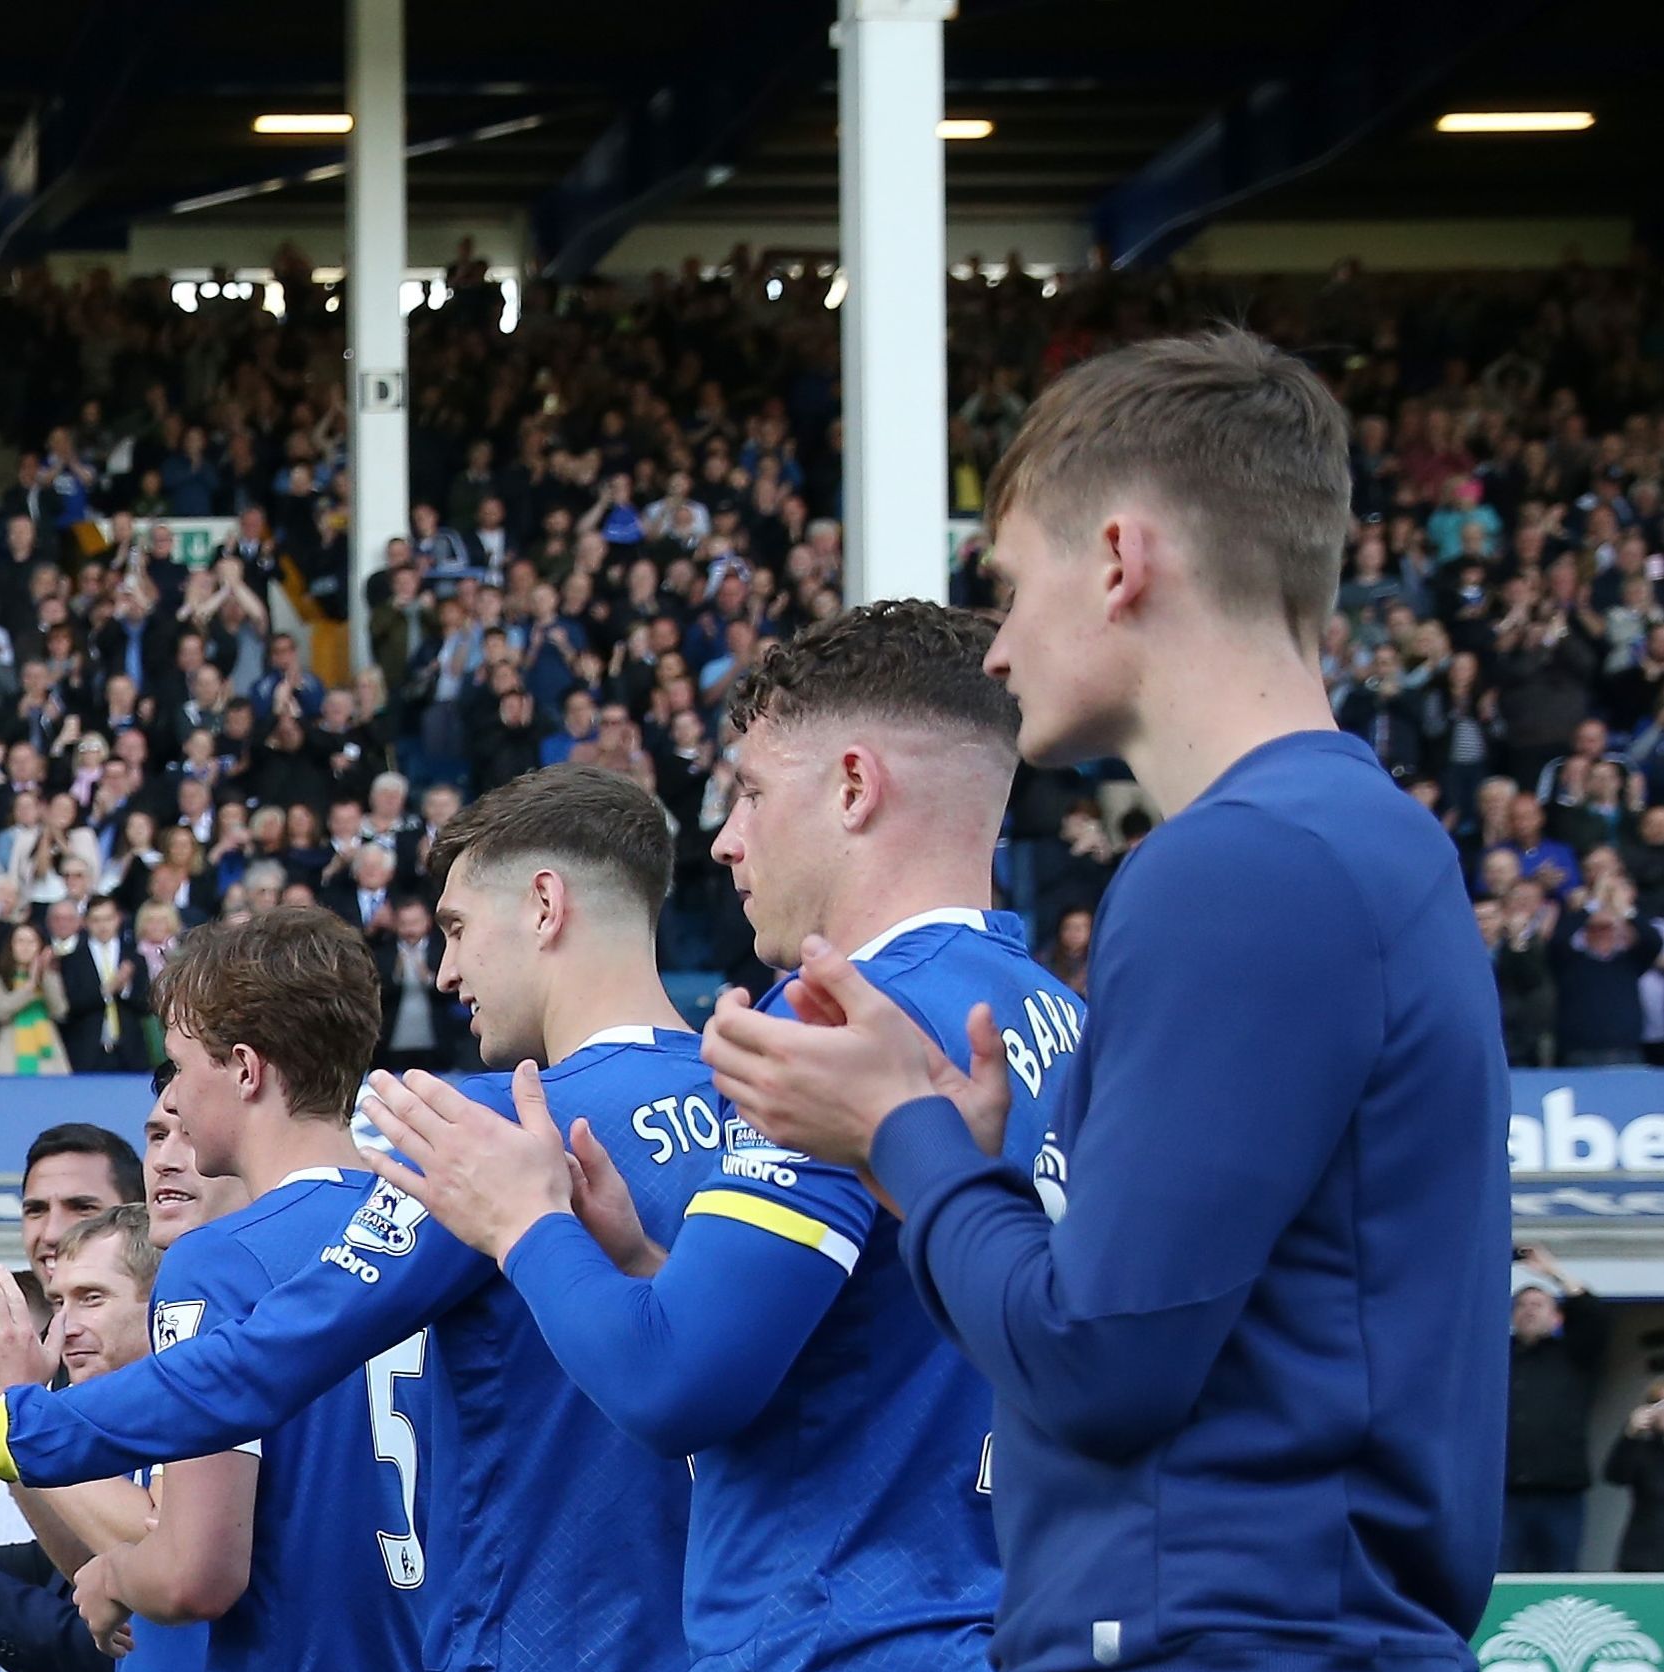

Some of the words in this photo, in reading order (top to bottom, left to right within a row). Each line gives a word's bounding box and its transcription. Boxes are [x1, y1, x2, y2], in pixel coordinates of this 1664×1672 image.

[631, 1095, 721, 1165] STO
[1506, 1085, 1664, 1172] abe
[365, 1328, 429, 1591] 5
